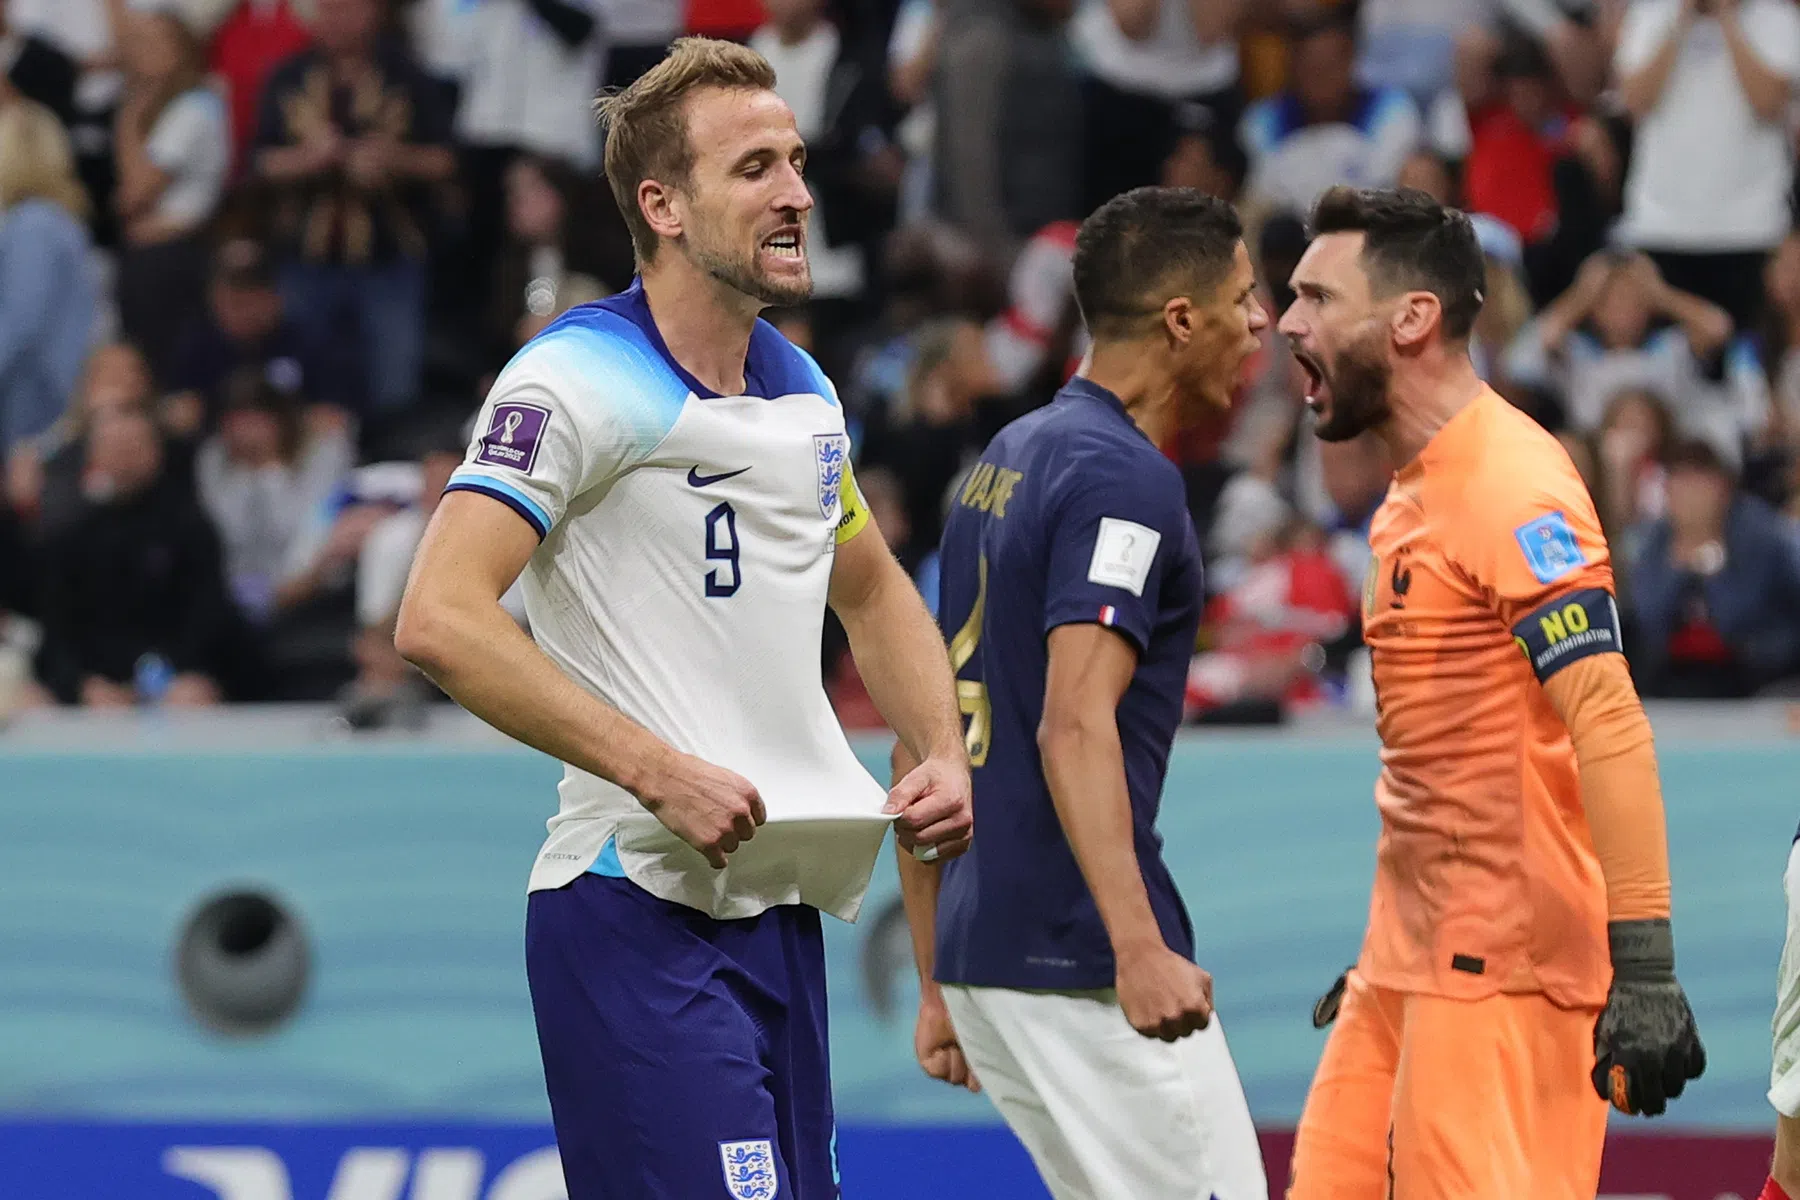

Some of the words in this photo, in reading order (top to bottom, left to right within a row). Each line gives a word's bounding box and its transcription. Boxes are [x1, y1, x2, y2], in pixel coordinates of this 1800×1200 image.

[705, 501, 741, 597] 9
[1540, 603, 1589, 645] NO
[1536, 628, 1612, 669] DISCRIMINATION
